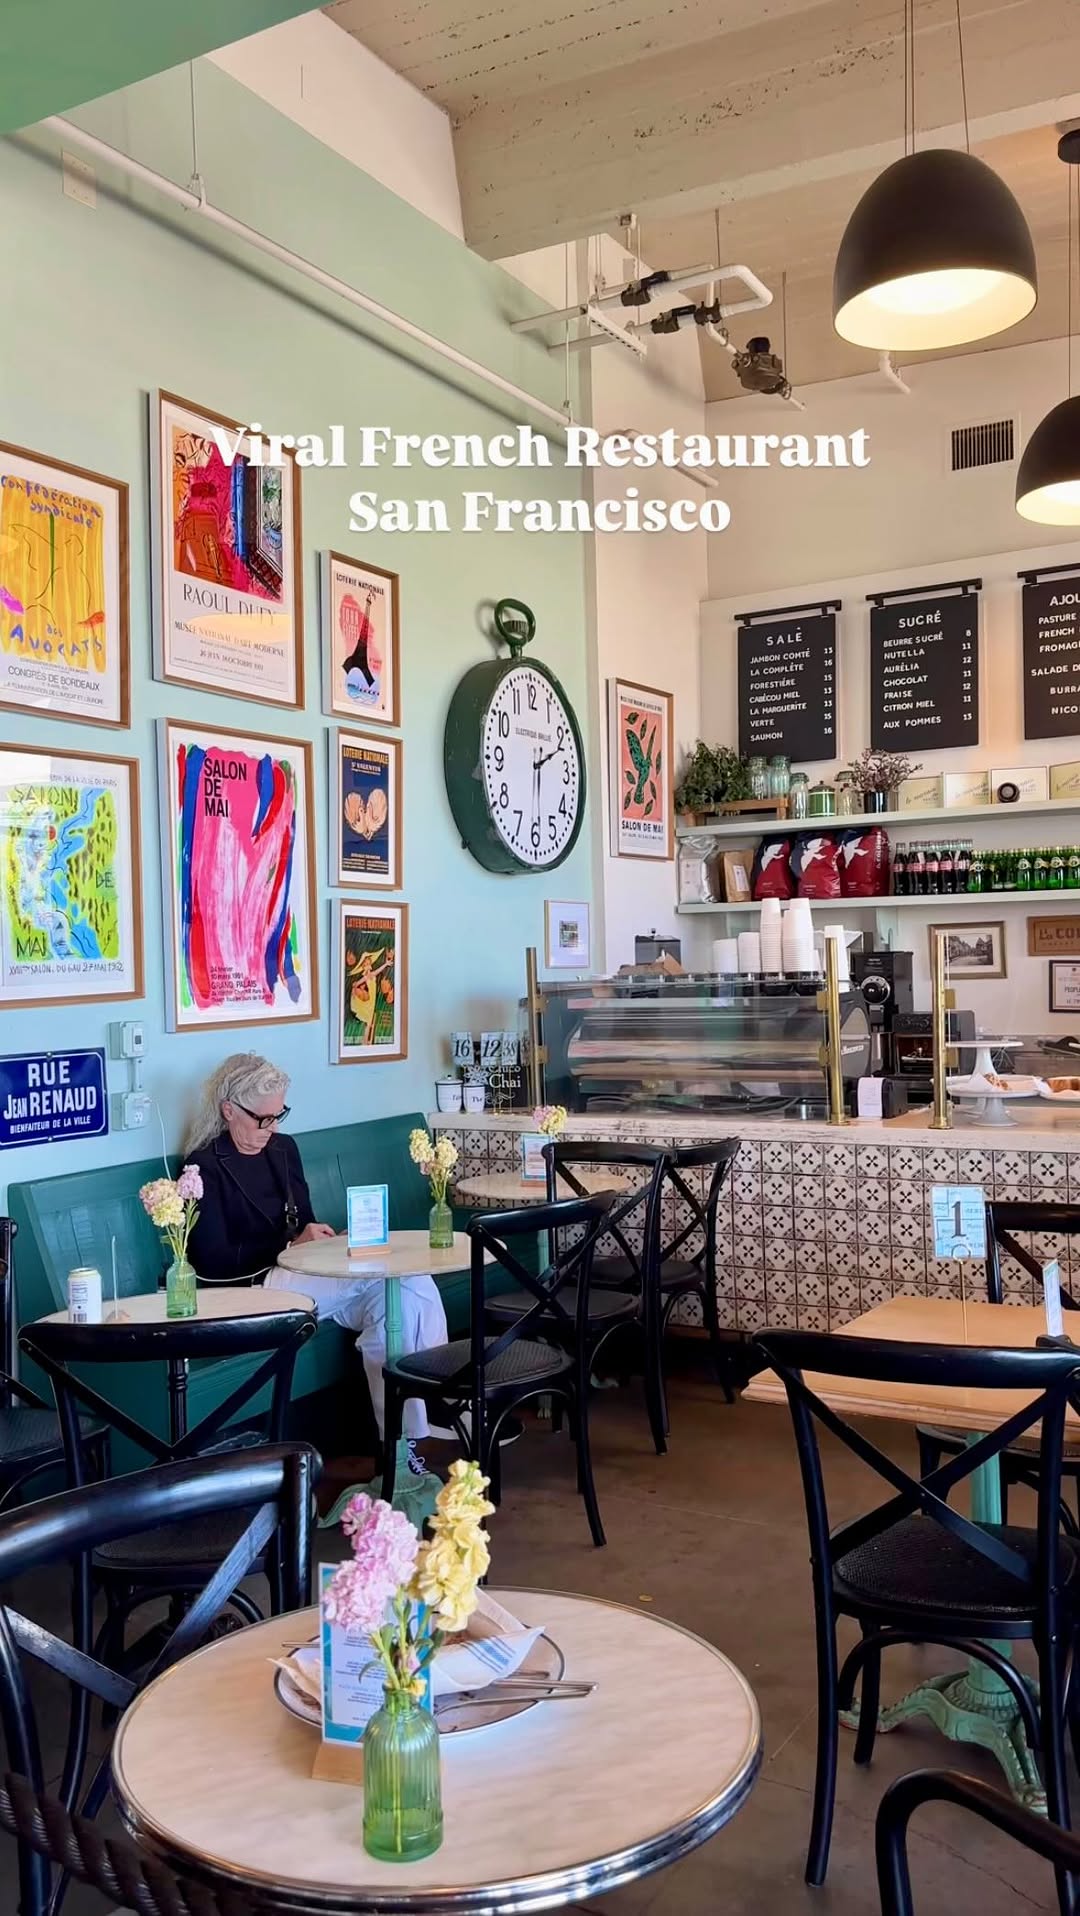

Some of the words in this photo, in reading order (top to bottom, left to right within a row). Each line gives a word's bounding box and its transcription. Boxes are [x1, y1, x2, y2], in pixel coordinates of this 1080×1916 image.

[183, 583, 233, 614] RAOUL
[898, 610, 942, 628] SUCRÉ
[1038, 613, 1077, 625] PASTURE
[10, 624, 102, 656] AVOCATS
[766, 627, 803, 646] SALÉ
[883, 637, 914, 649] BEURRE
[915, 631, 943, 644] SUCRÉ
[1039, 627, 1075, 639] FRENCH
[750, 654, 780, 665] JAMBON
[883, 648, 925, 660] NUTELLA
[962, 642, 971, 650] 11
[750, 668, 760, 677] LA
[1031, 664, 1069, 677] SALADE
[48, 673, 60, 684] DE
[60, 675, 100, 692] BORDEAUX
[883, 674, 929, 687] CHOCOLAT
[512, 687, 521, 715] 11
[526, 683, 538, 711] 12
[884, 690, 913, 700] FRAISE
[750, 707, 760, 716] LA
[883, 702, 914, 713] CITRON
[915, 700, 936, 710] MIEL
[1051, 704, 1080, 715] NICO
[498, 710, 510, 739] 10
[750, 718, 775, 728] VERTE
[883, 719, 900, 729] AUX
[905, 716, 942, 728] POMMES
[556, 725, 566, 751] 2
[750, 731, 783, 742] SAUMON
[494, 745, 504, 772] 9
[204, 757, 248, 781] SALON
[563, 760, 571, 785] 3
[204, 777, 222, 797] DE
[500, 782, 509, 809] 8
[204, 797, 229, 818] MAI
[558, 792, 567, 818] 4
[513, 810, 523, 837] 7
[548, 815, 557, 841] 5
[622, 820, 641, 831] SALON
[643, 822, 652, 832] DE
[530, 821, 541, 848] 6
[454, 1039, 470, 1057] 16
[28, 1061, 70, 1087] RUE
[489, 1073, 521, 1088] Chai
[29, 1086, 97, 1117] RENAUD
[10, 1120, 50, 1134] BIENFAITEUR
[53, 1119, 61, 1128] DE
[64, 1118, 72, 1127] LA
[73, 1115, 91, 1125] VILLE
